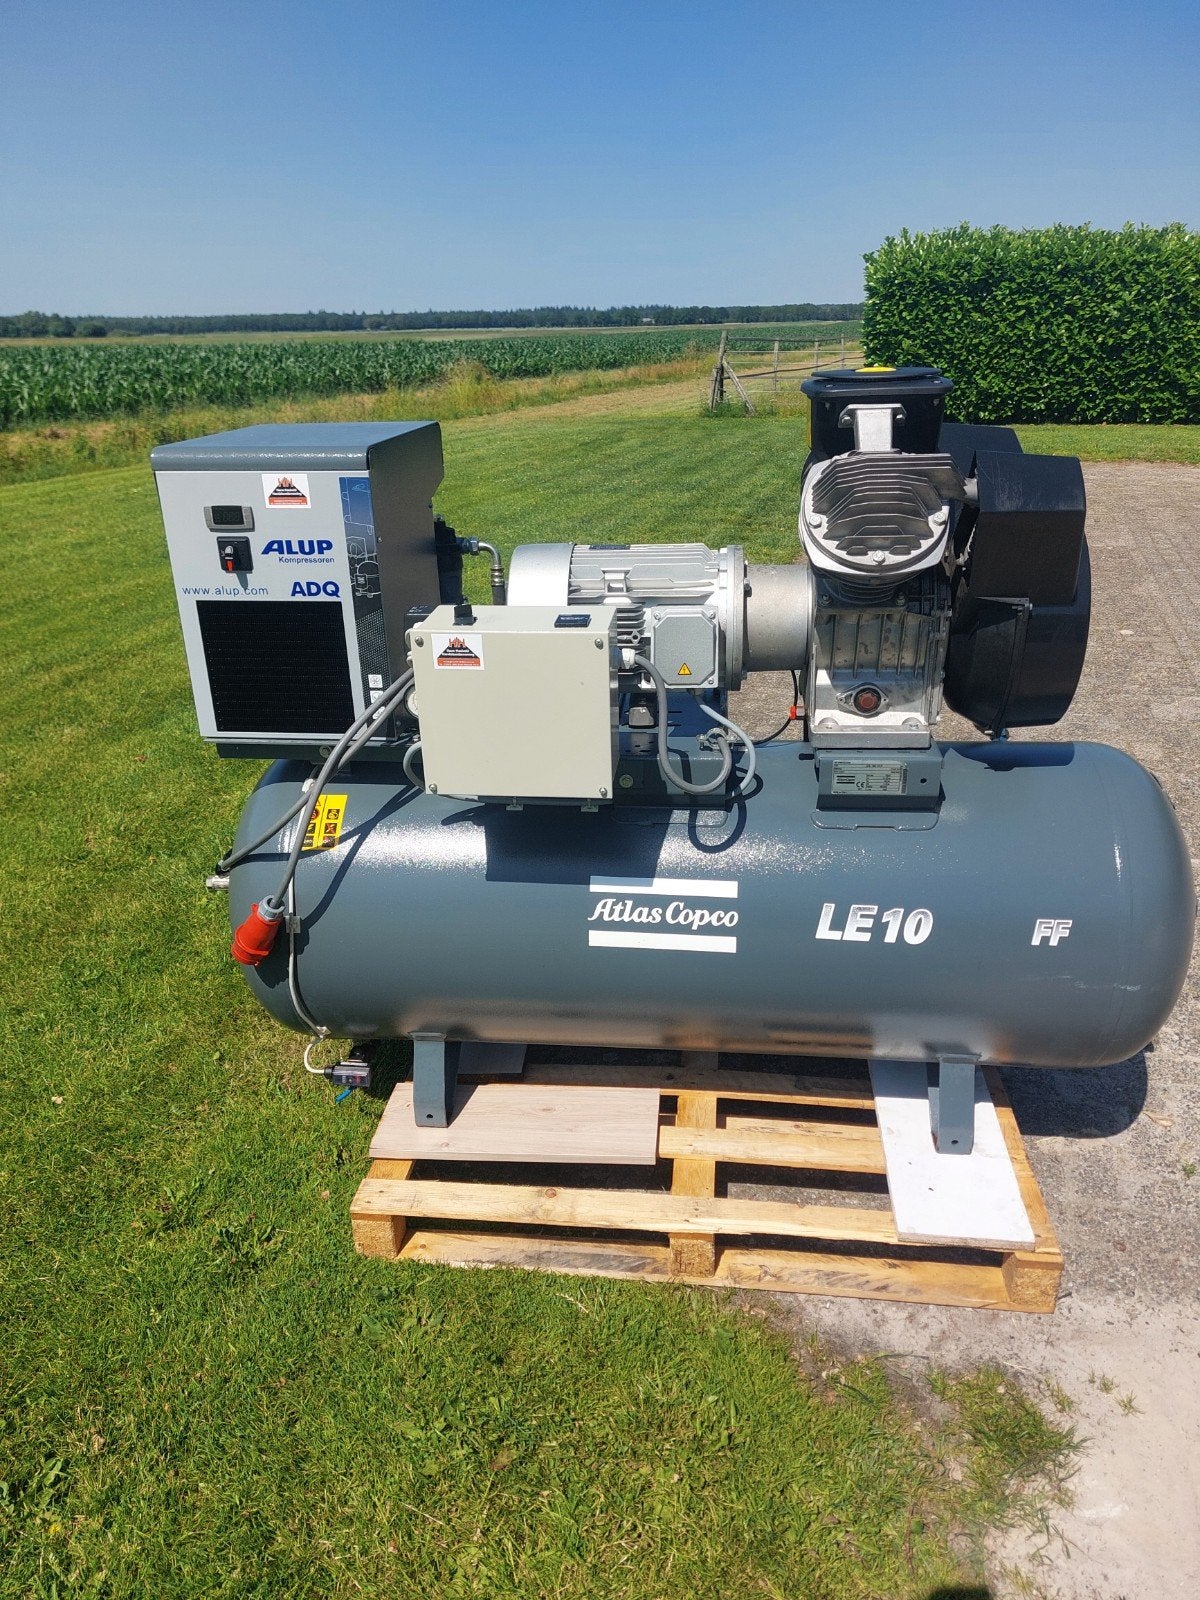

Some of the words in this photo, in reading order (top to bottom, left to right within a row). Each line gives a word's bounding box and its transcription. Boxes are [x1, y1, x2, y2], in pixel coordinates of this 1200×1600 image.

[261, 540, 333, 555] ALUP
[279, 556, 335, 564] Kompressoren
[182, 586, 268, 597] www.alup.com
[291, 580, 341, 598] ADQ
[587, 898, 663, 924] Atlas
[665, 901, 739, 931] Copco
[1031, 918, 1073, 946] FF
